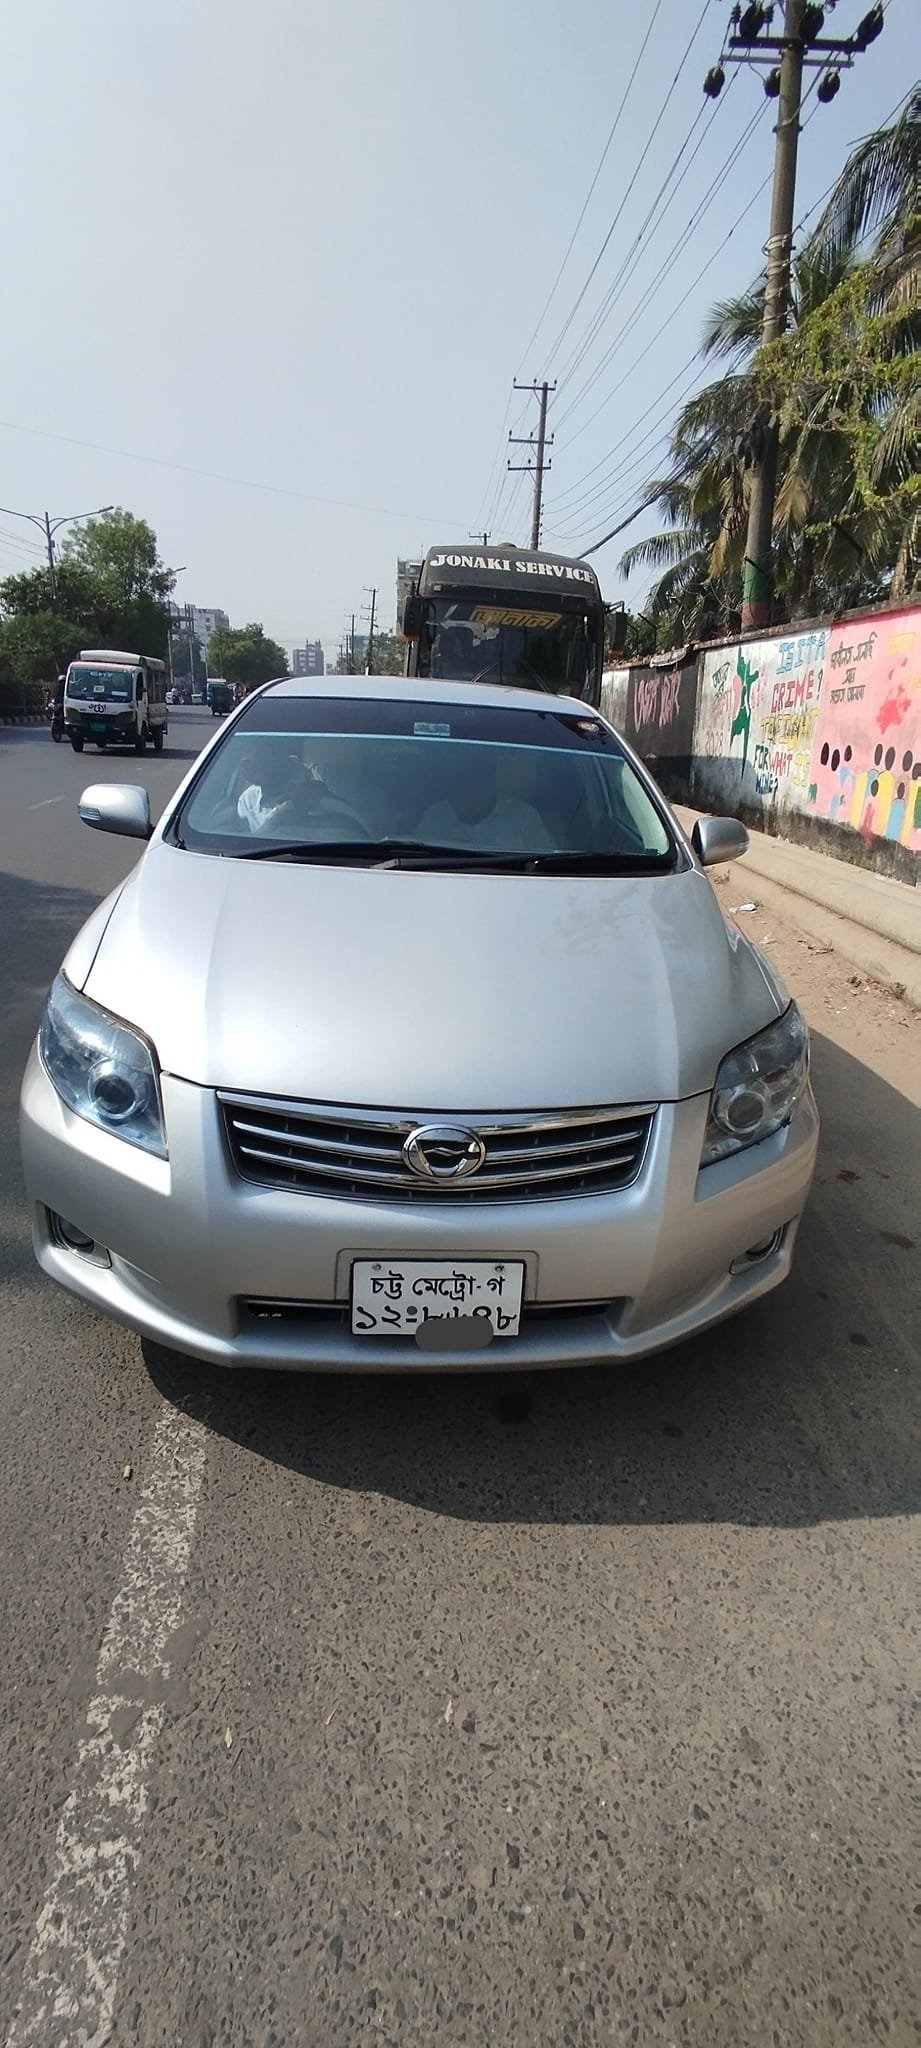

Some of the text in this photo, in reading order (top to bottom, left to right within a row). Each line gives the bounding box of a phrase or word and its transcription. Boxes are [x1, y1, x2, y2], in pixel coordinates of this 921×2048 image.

[429, 554, 595, 585] JONAKI SERVICE
[753, 744, 769, 771] FOR
[769, 751, 793, 777] WHAT
[370, 1270, 405, 1300] চট্ট
